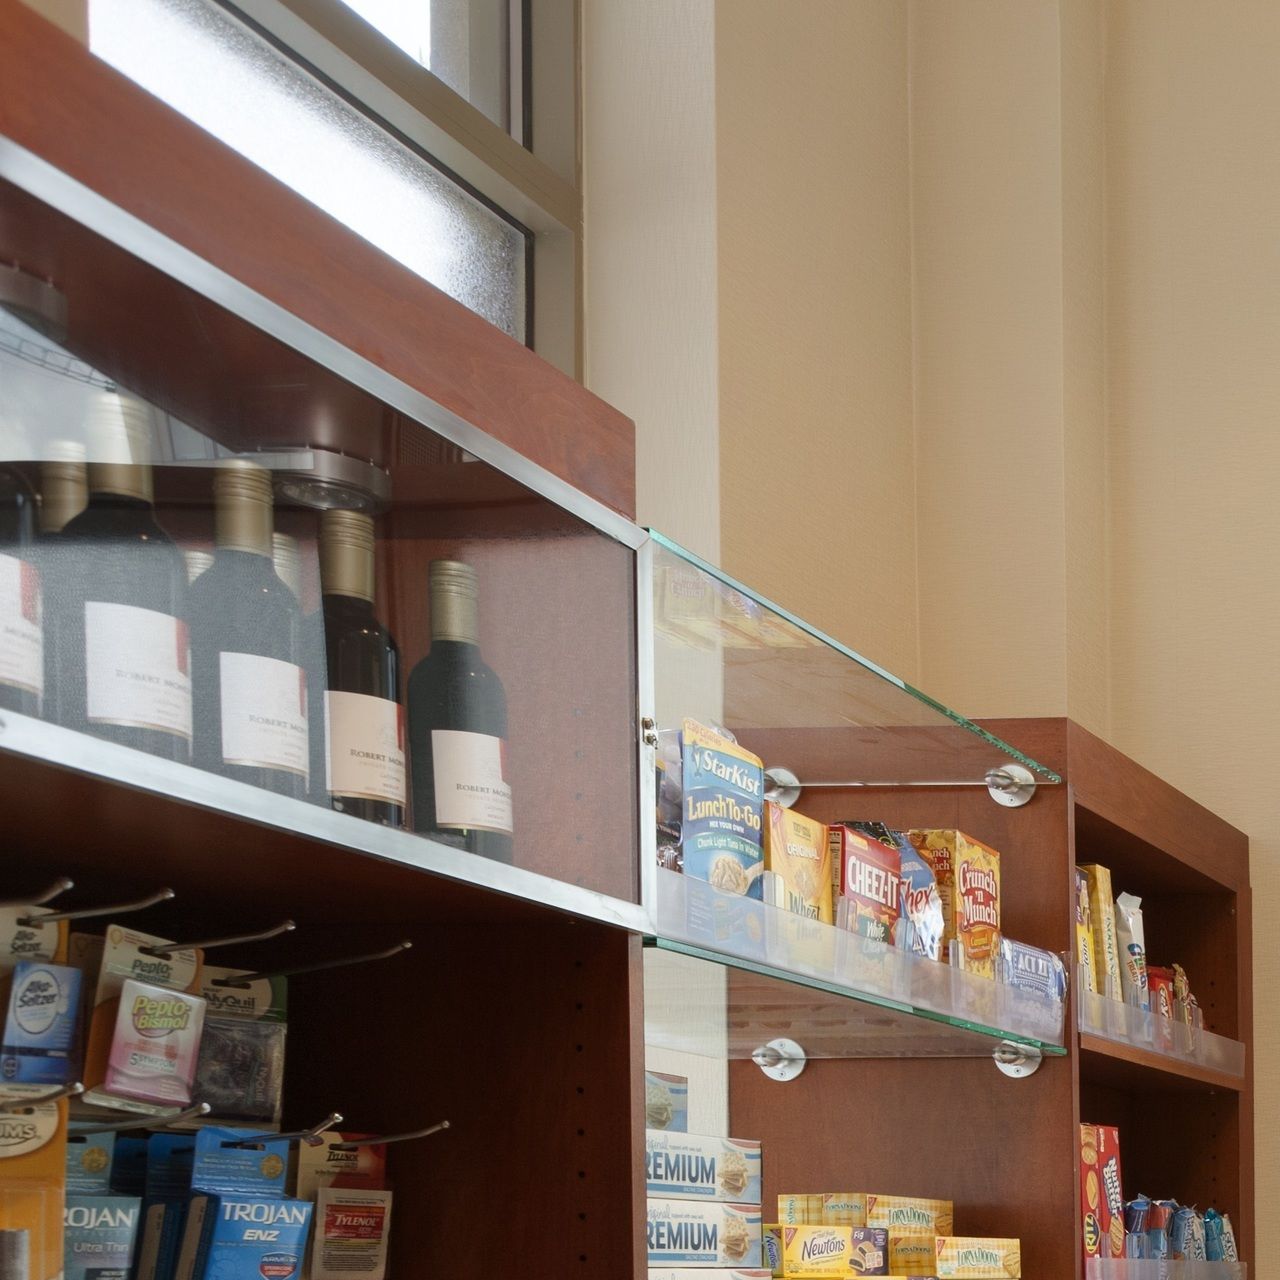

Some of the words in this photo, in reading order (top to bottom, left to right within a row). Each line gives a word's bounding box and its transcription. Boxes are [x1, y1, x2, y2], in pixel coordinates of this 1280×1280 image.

[350, 749, 386, 763] ROBERT
[702, 749, 761, 797] StarKist
[456, 783, 490, 795] ROBERT
[686, 793, 727, 821] Lunch
[725, 797, 761, 831] To-Go
[848, 856, 899, 910] CHEEZ-IT
[959, 860, 997, 898] Crunch
[788, 891, 821, 921] Wheat
[962, 895, 997, 926] Munch
[1016, 954, 1038, 972] ACT
[1038, 958, 1049, 976] II
[133, 994, 192, 1015] Pepto-
[137, 1012, 188, 1031] Bismol
[646, 1150, 716, 1185] REMIUM
[64, 1207, 133, 1229] ROJAN
[223, 1202, 306, 1226] TROJAN
[334, 1213, 380, 1227] TYLENOL
[243, 1229, 281, 1241] ENZ
[647, 1221, 718, 1251] REMIUM
[853, 1230, 865, 1240] Fig
[801, 1238, 846, 1261] Newtons
